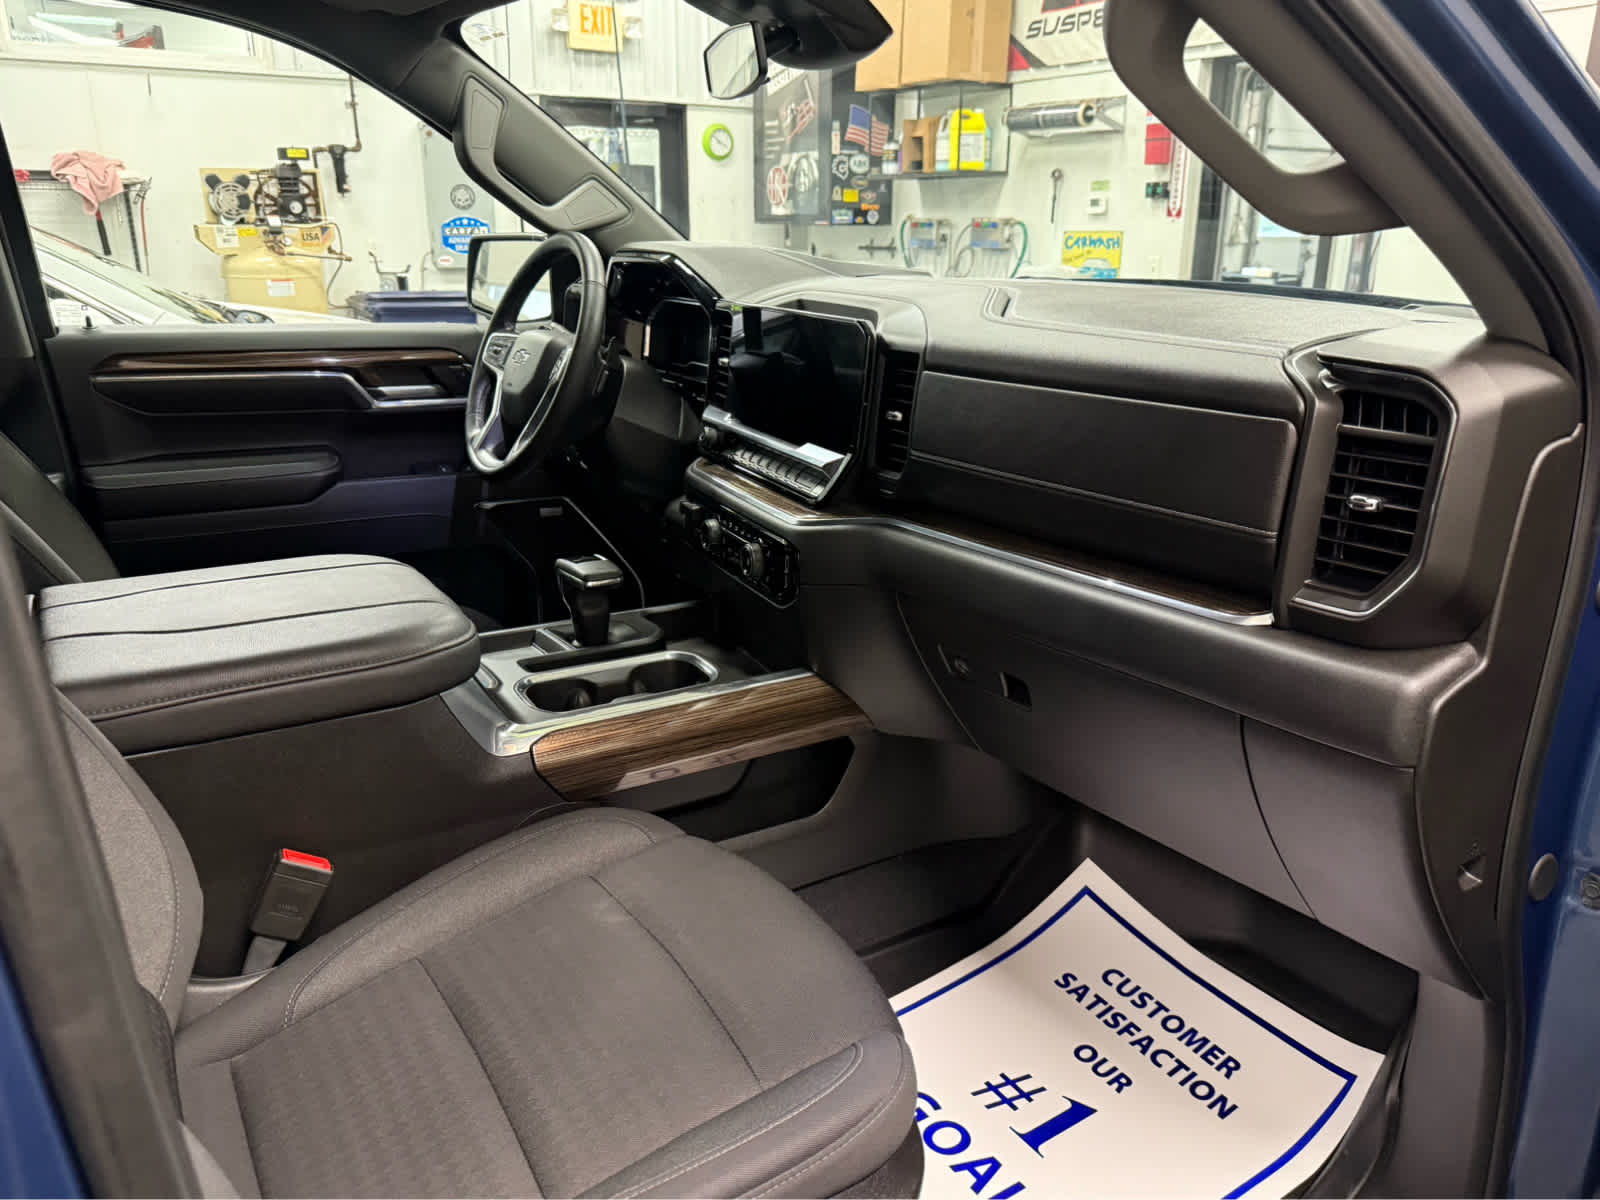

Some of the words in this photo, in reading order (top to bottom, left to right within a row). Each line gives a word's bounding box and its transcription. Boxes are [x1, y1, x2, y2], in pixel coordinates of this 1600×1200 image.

[580, 3, 615, 35] EXIT
[302, 233, 320, 241] USA
[1053, 971, 1239, 1121] SATISFACTION
[1100, 967, 1242, 1080] CUSTOMER
[1072, 1043, 1134, 1095] OUR
[970, 1072, 1098, 1158] #1
